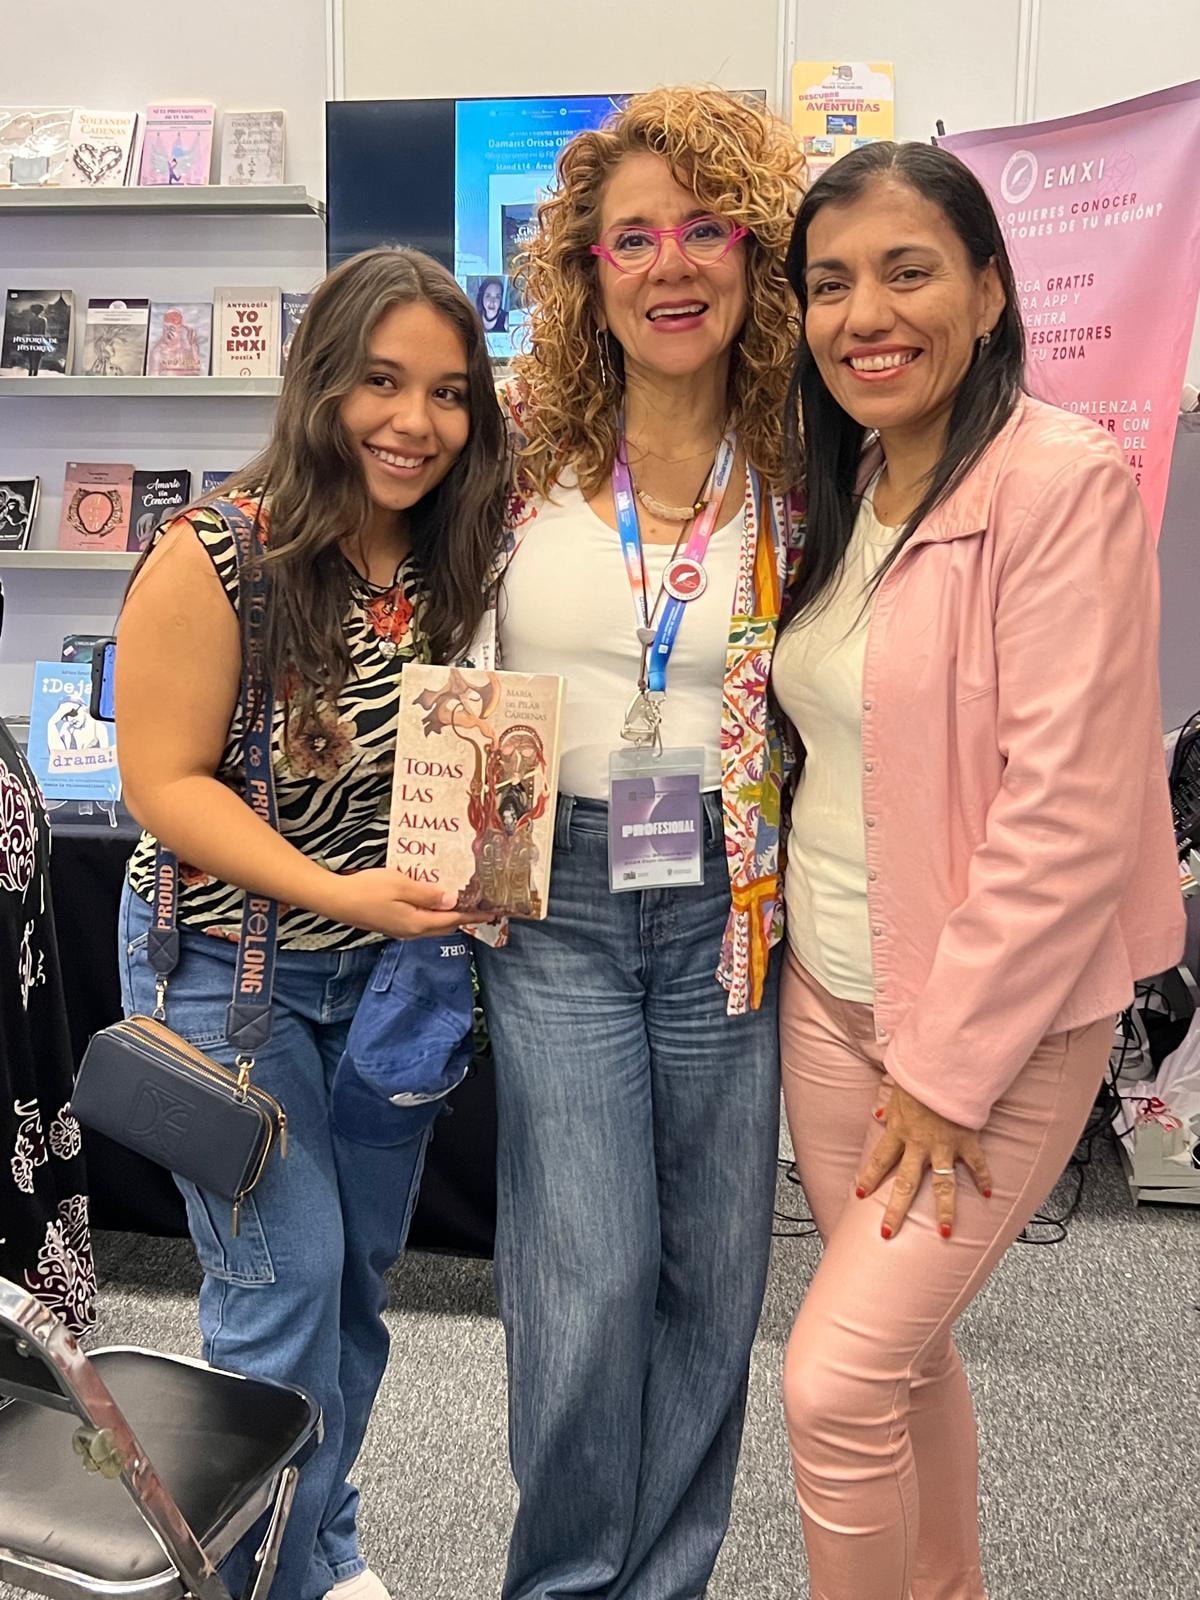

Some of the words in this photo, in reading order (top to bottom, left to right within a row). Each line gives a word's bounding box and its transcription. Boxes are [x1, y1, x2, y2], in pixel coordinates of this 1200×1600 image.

[798, 91, 840, 101] DESCUBRE
[806, 102, 880, 112] AVENTURAS
[79, 114, 131, 126] SOLTANDO
[80, 124, 127, 136] CADENAS
[488, 138, 525, 149] Damaris
[526, 138, 554, 147] Orissa
[496, 162, 516, 171] Stand
[1043, 158, 1105, 189] EMXI
[1071, 192, 1137, 215] CONOCER
[1009, 224, 1052, 240] TORES
[1059, 219, 1076, 233] DE
[1082, 216, 1099, 230] TU
[1104, 202, 1163, 227] REGIÓN?
[1015, 279, 1041, 294] RGA
[1046, 272, 1095, 292] GRATIS
[226, 301, 268, 309] ANTOLOGÍA
[1020, 296, 1038, 310] RA
[1043, 293, 1068, 309] APP
[1073, 291, 1081, 305] Y
[235, 310, 259, 323] YO
[1022, 311, 1067, 328] ENTRA
[231, 325, 263, 338] SOY
[1030, 325, 1112, 345] ESCRITORES
[226, 340, 266, 352] EMXI
[1031, 348, 1047, 361] TU
[1052, 345, 1086, 361] ZONA
[1143, 399, 1152, 412] A
[1096, 419, 1116, 433] AR
[1123, 418, 1150, 432] CON
[1123, 436, 1147, 450] DEL
[1127, 454, 1144, 469] AL
[146, 478, 181, 490] Amarte
[41, 677, 93, 698] ¡Deja
[518, 701, 540, 710] PILAR
[53, 751, 113, 768] drama!
[402, 757, 464, 779] TODAS
[401, 784, 434, 804] LAS
[398, 812, 460, 833] ALMAS
[621, 819, 696, 838] PROFESIONAL
[397, 836, 436, 856] SON
[397, 860, 440, 884] MÍAS
[157, 864, 175, 929] PROUD
[440, 944, 466, 957] ORK
